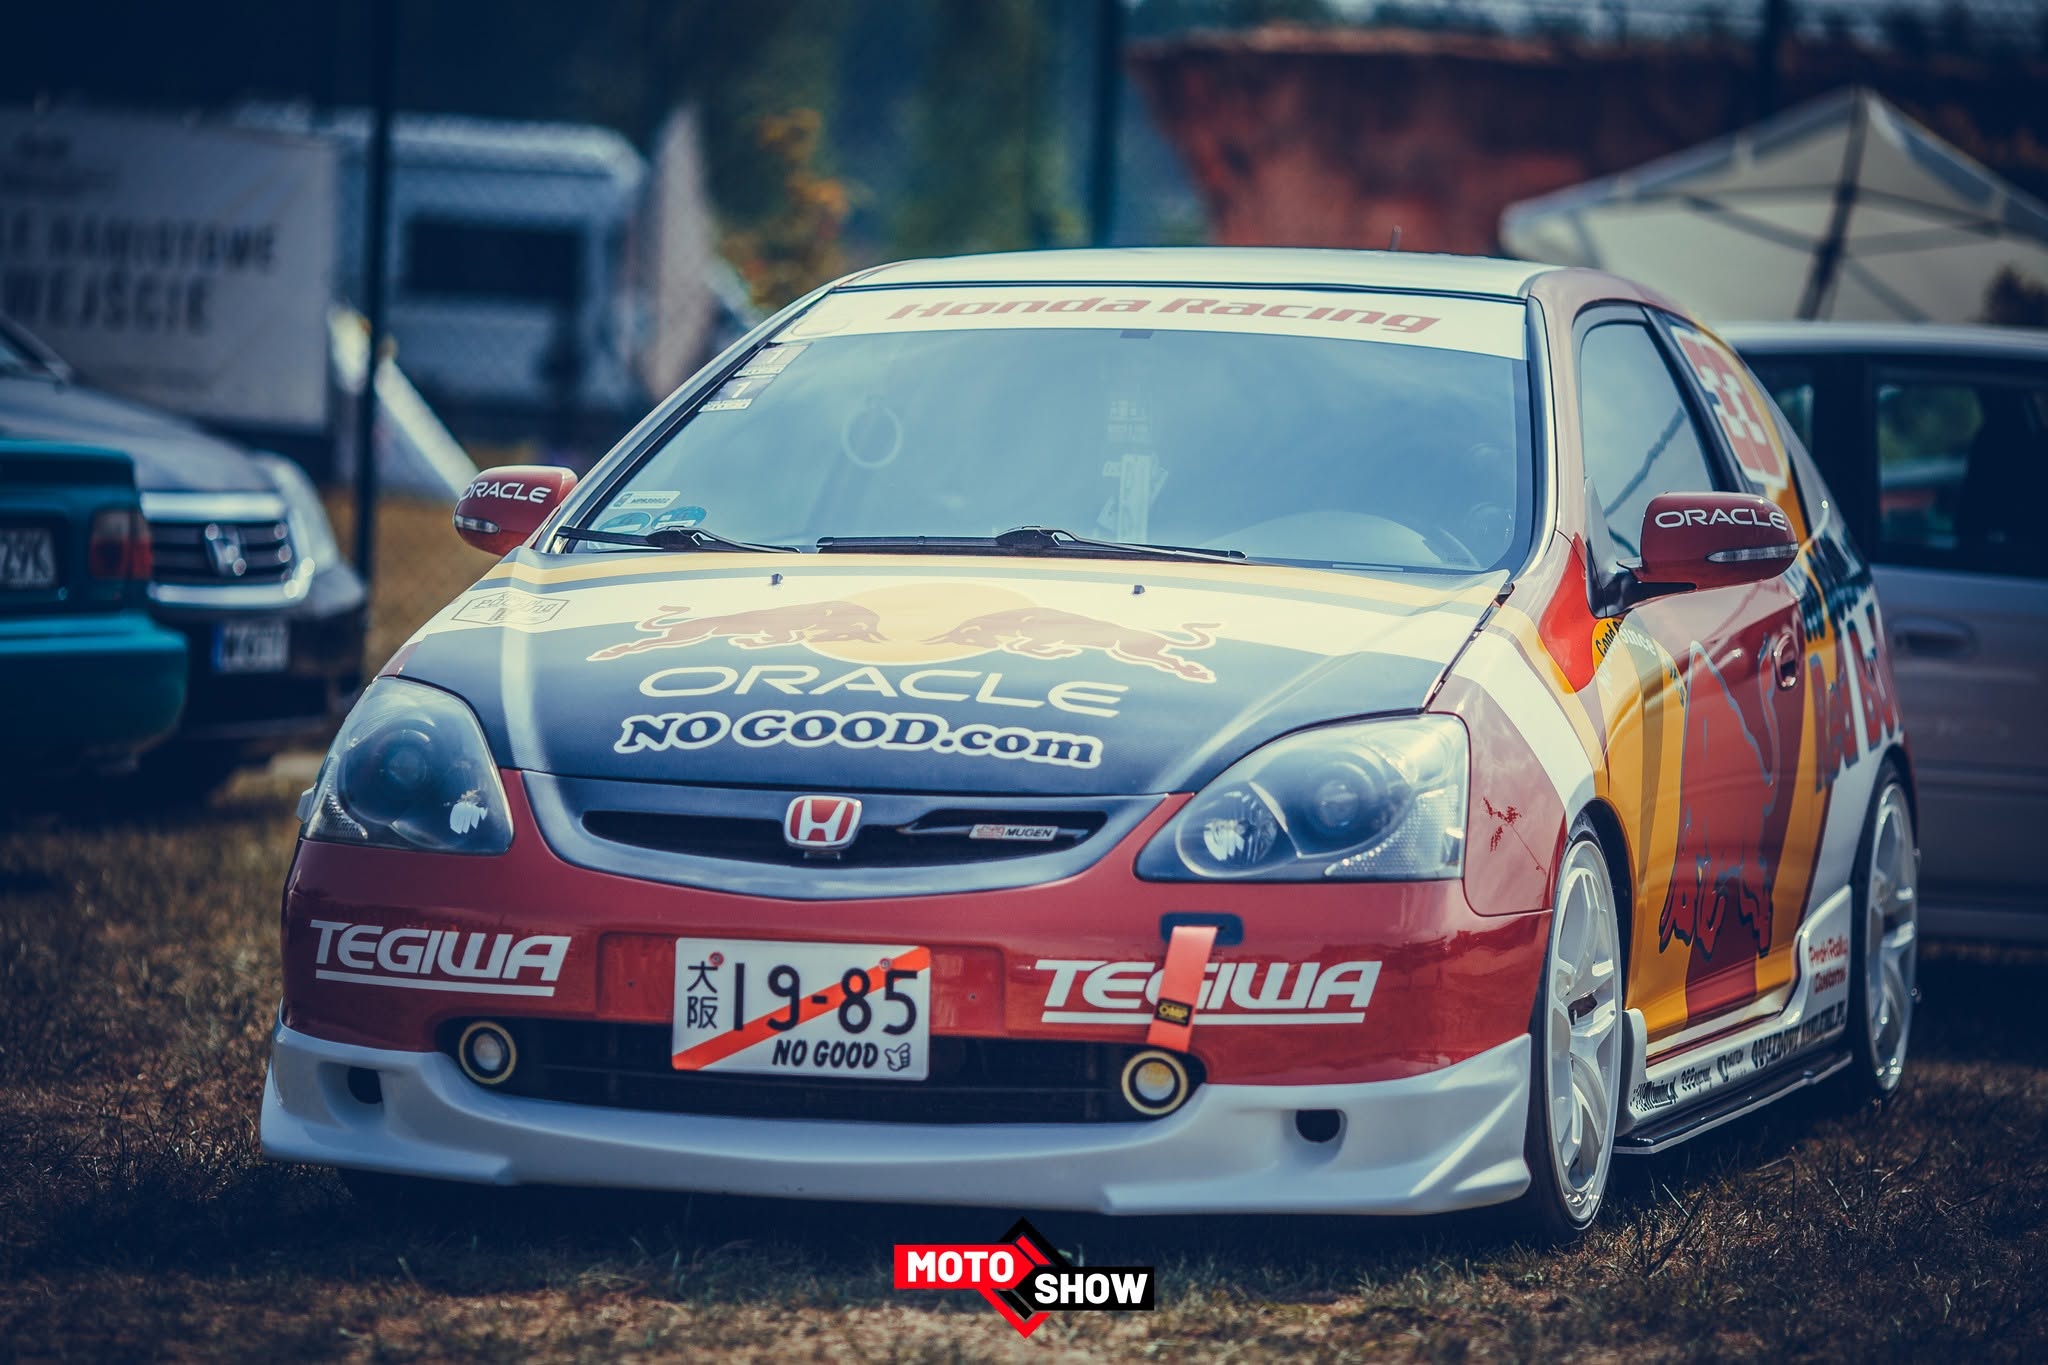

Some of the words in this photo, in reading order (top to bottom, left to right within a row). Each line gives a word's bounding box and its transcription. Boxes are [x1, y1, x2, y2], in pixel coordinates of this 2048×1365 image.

[887, 297, 1148, 320] Honda
[1157, 297, 1441, 333] Racing
[1654, 508, 1788, 531] ORACLE
[637, 664, 1129, 719] ORACLE
[614, 710, 730, 754] NO
[732, 709, 1103, 770] GOOD.com
[1005, 827, 1053, 839] MUGEN
[310, 919, 573, 982] TEGIWA
[686, 961, 719, 1030] 大阪
[732, 962, 918, 1036] 19-85
[772, 1039, 809, 1067] NO
[813, 1040, 879, 1069] GOOD
